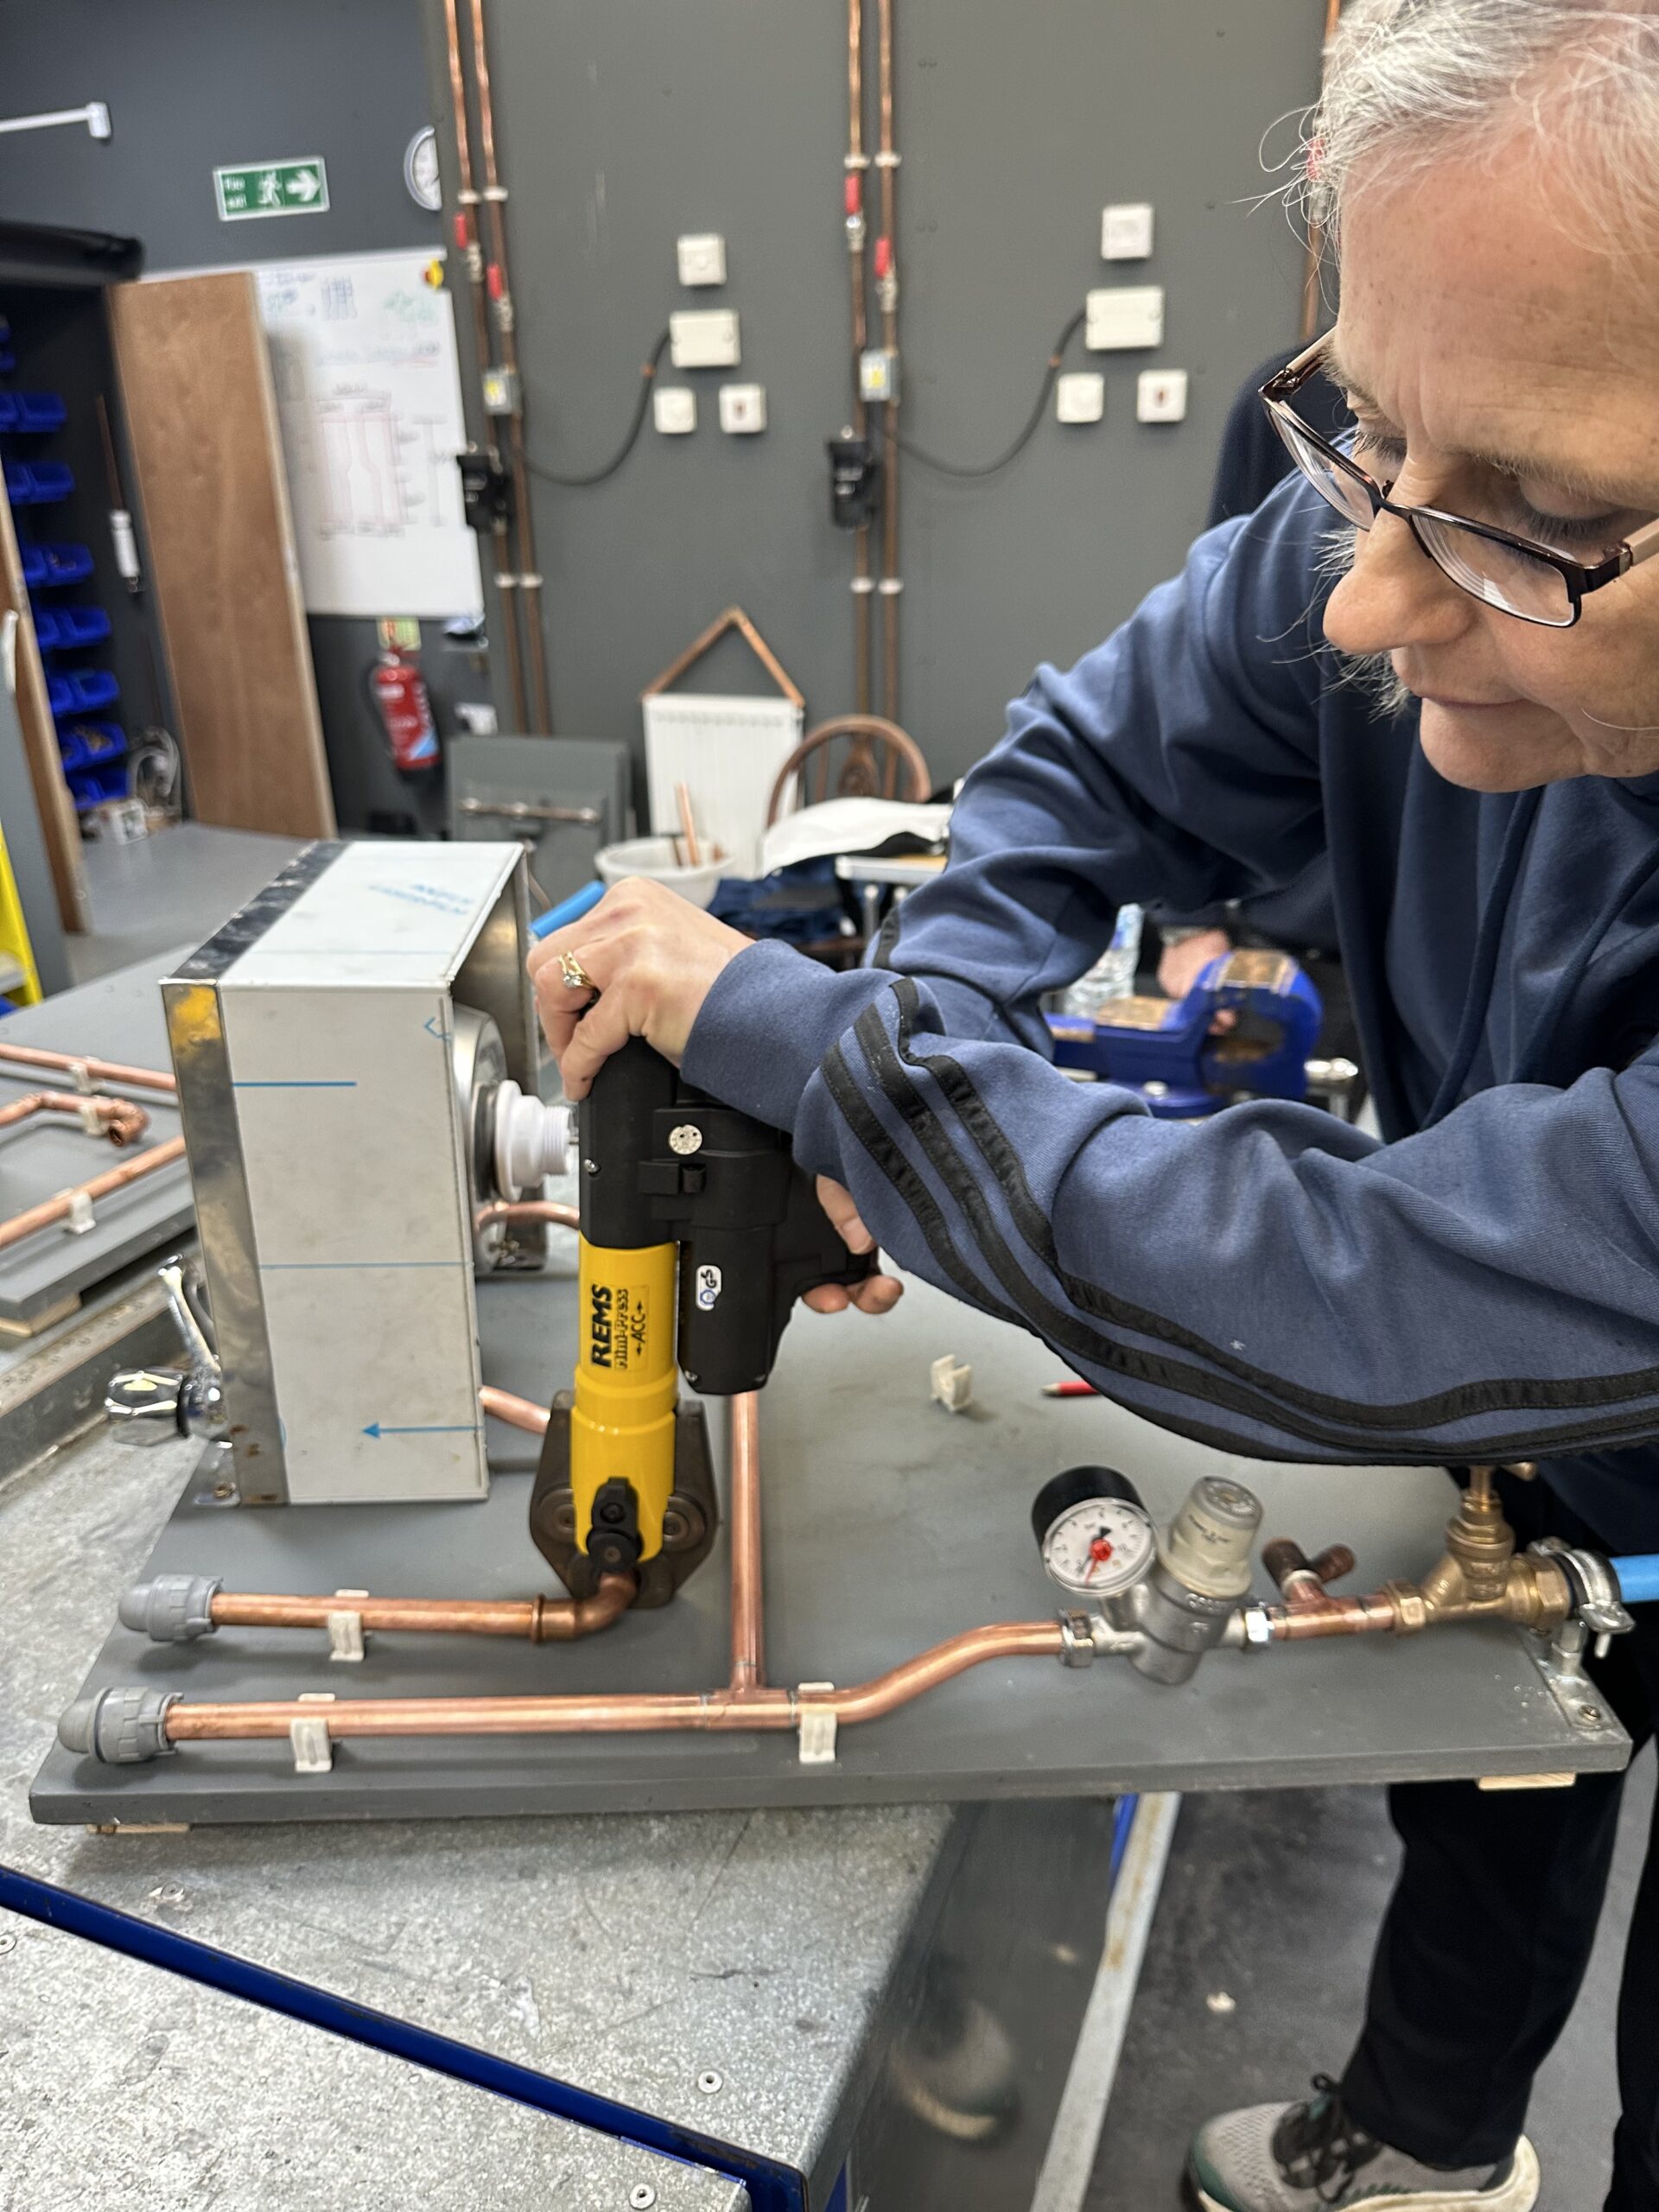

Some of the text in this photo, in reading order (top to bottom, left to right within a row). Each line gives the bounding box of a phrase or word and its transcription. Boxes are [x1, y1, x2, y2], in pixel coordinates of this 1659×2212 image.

[592, 1283, 613, 1368] REMS
[614, 1287, 629, 1370] Mini-Press
[631, 1313, 645, 1344] ACC
